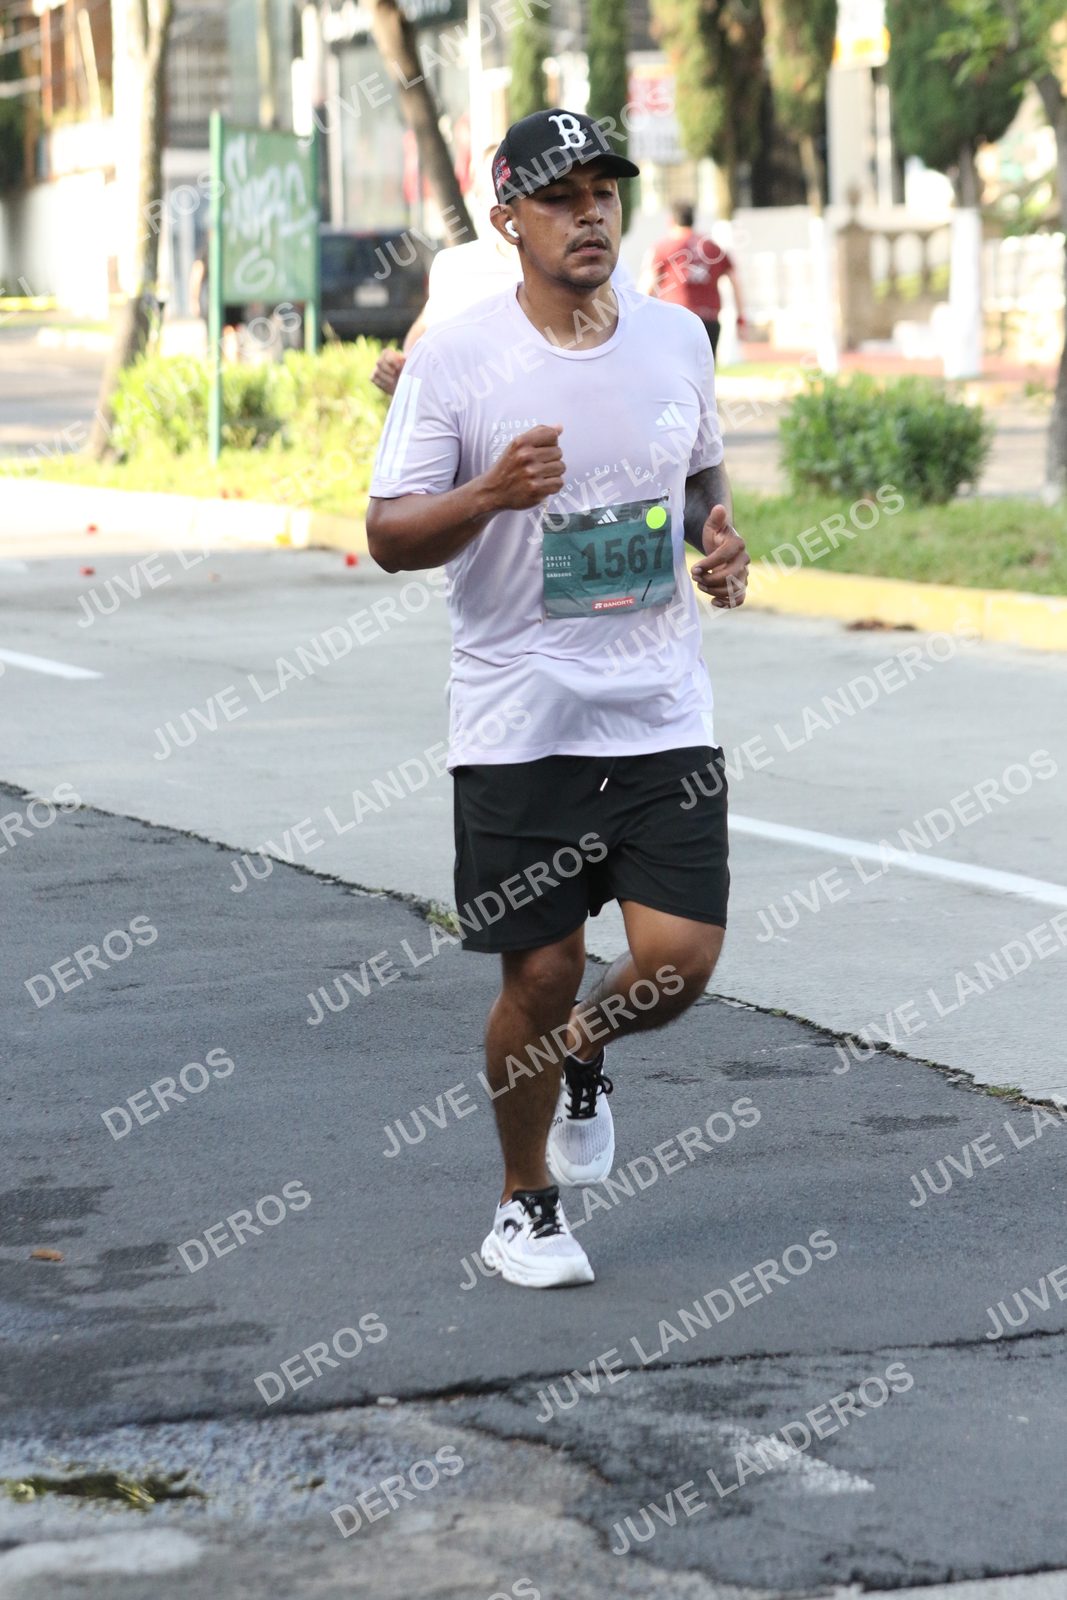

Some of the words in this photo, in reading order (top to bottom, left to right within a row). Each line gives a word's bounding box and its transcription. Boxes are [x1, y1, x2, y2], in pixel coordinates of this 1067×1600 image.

[548, 113, 587, 150] B
[492, 418, 537, 430] ADIDAS
[594, 464, 618, 476] GDL
[581, 530, 667, 582] 1567
